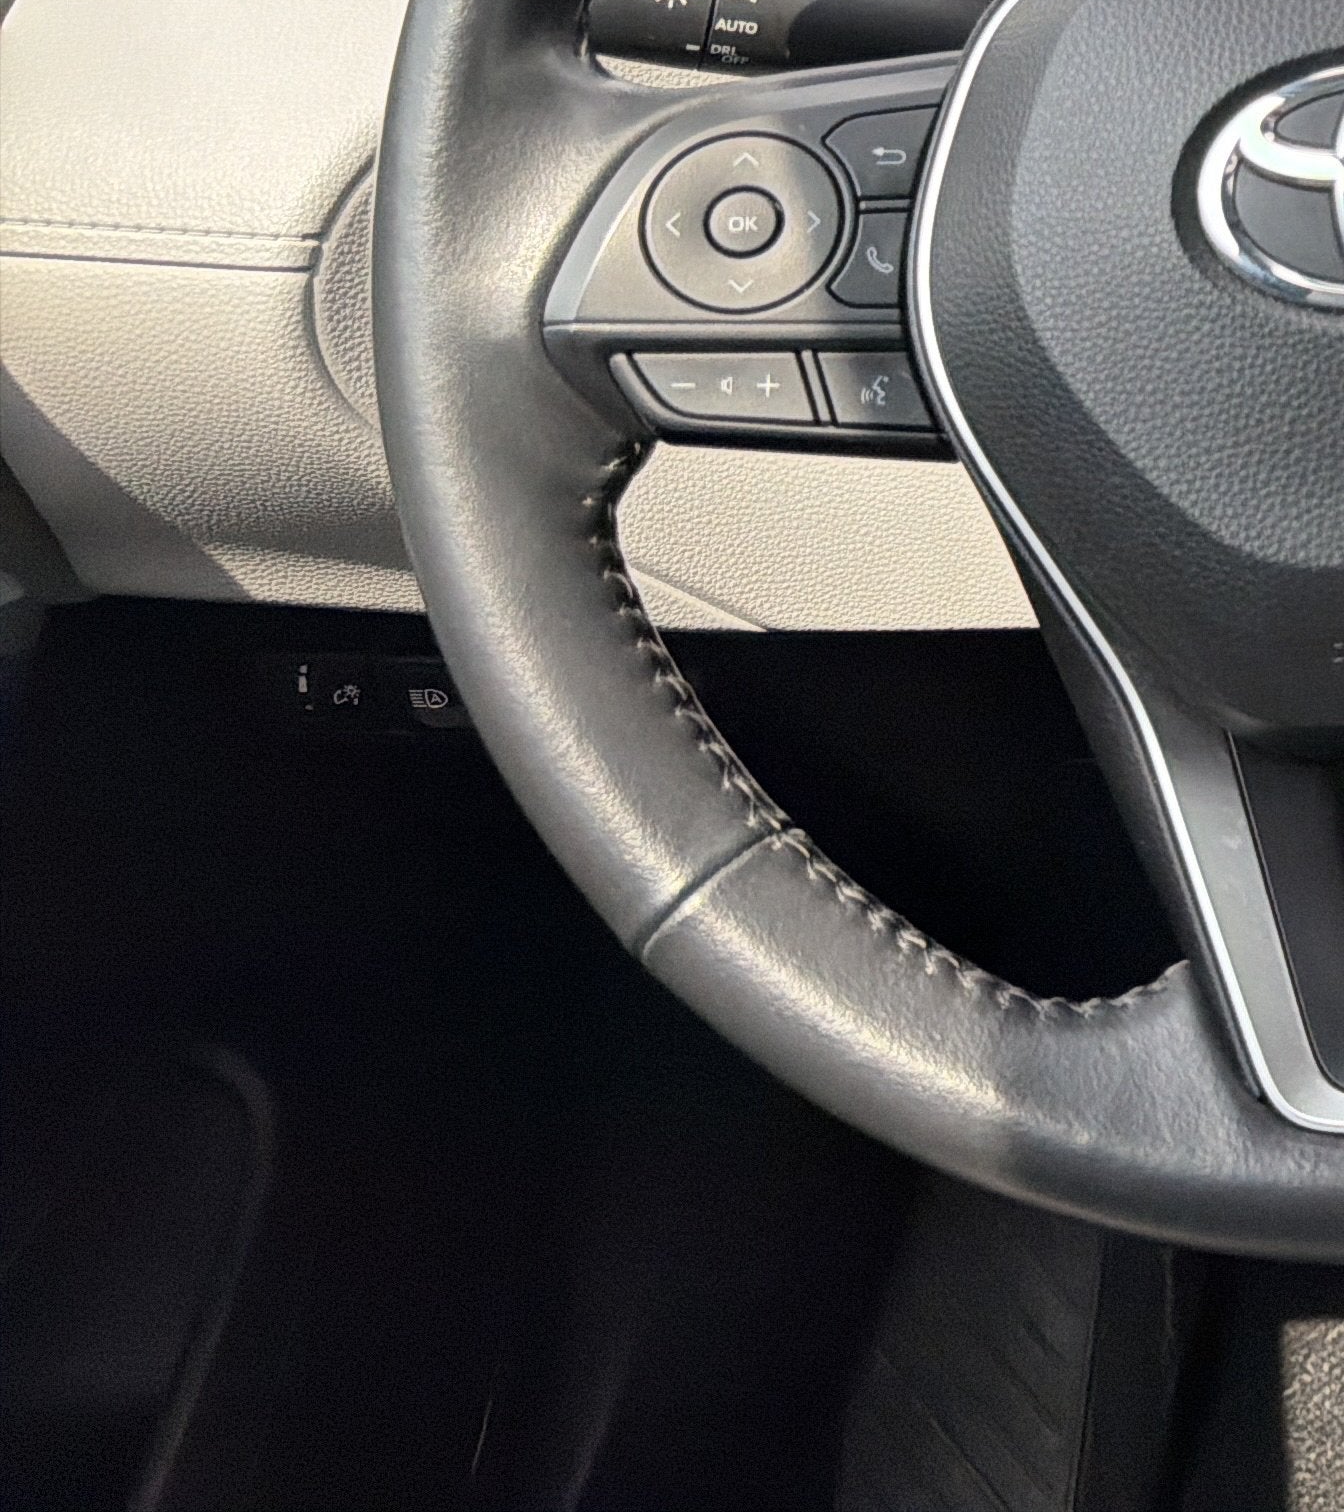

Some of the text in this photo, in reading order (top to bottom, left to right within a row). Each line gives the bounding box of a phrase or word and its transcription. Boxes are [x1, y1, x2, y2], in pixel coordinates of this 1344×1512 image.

[714, 17, 759, 36] AUTO
[721, 54, 751, 65] OFF
[728, 216, 758, 232] OK
